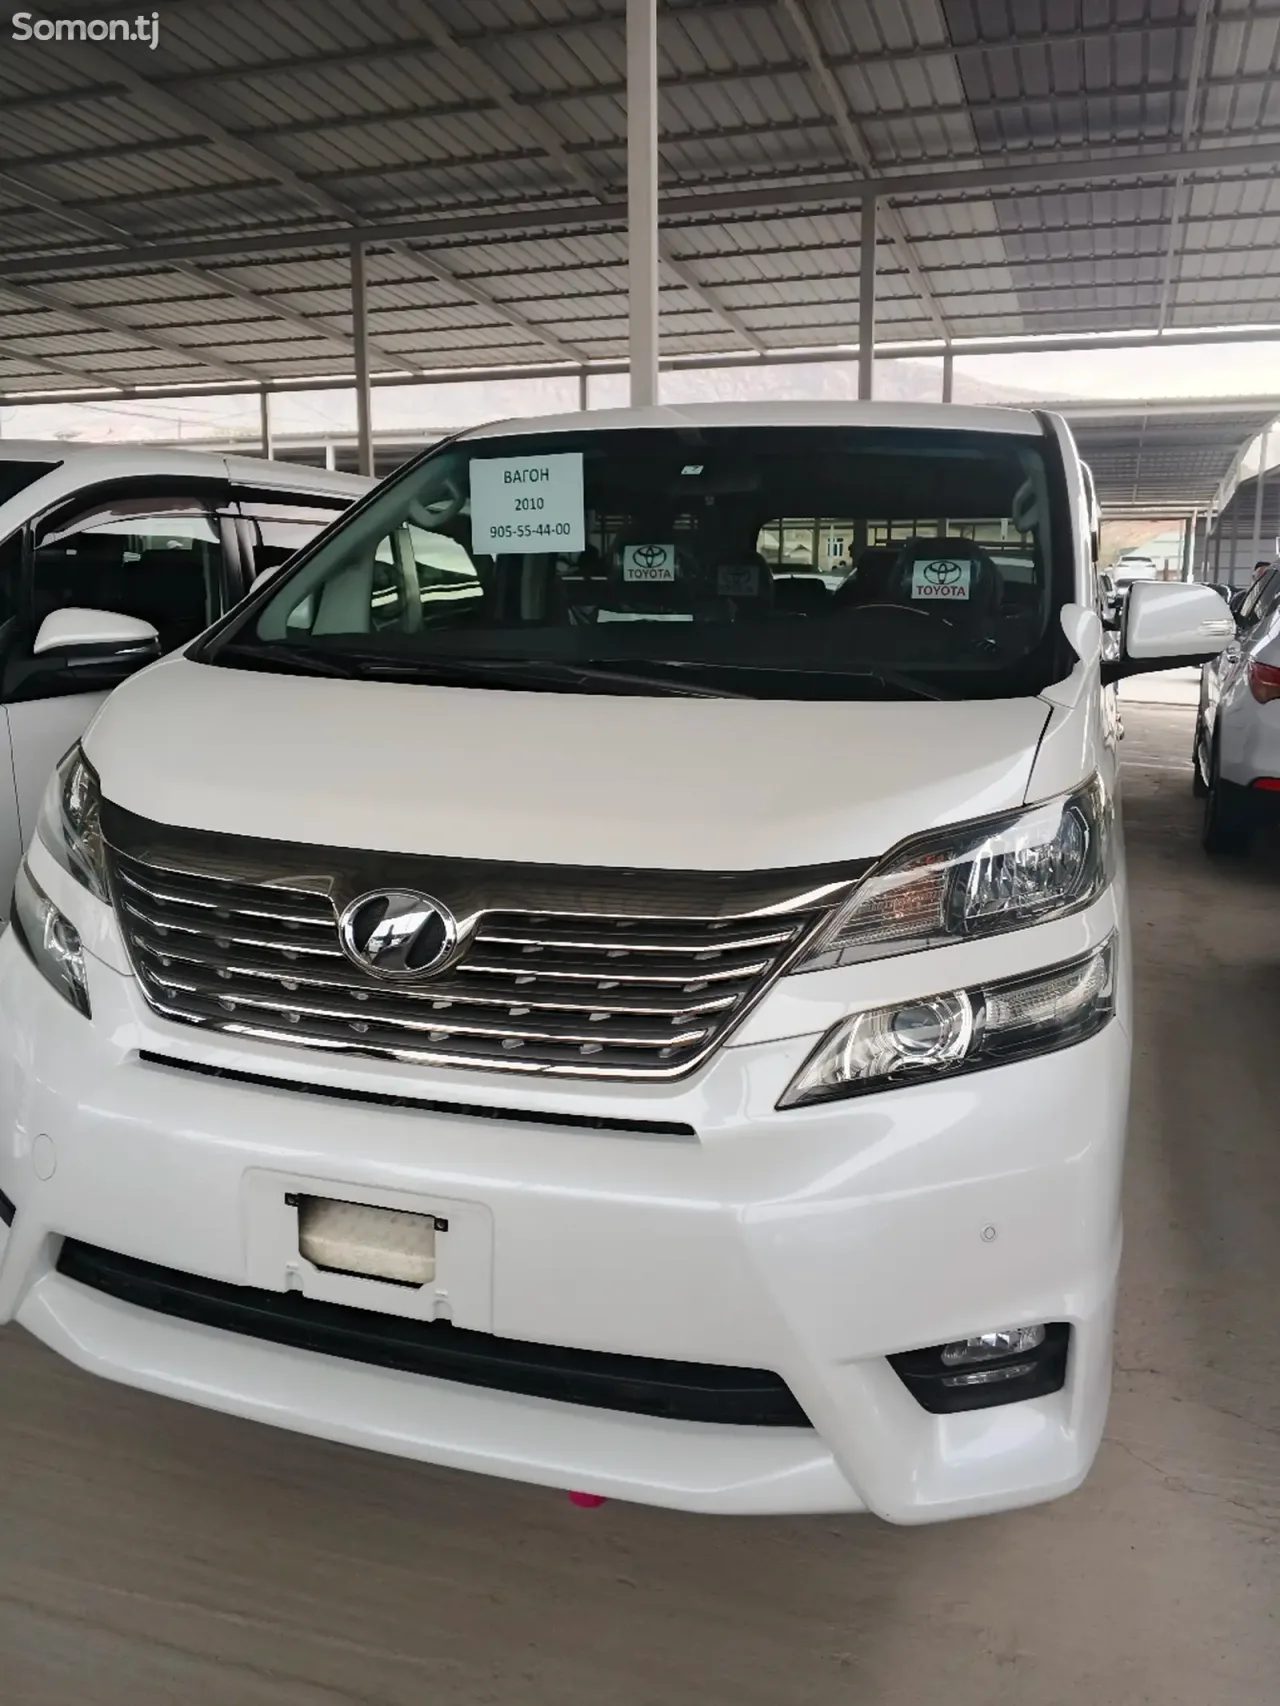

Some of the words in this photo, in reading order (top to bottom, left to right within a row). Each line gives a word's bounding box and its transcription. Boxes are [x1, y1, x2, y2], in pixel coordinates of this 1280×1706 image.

[503, 467, 550, 484] ВАГОН
[514, 497, 545, 512] 2010
[489, 522, 571, 538] 905-55-44-00
[627, 568, 672, 579] TOYOTA
[916, 585, 966, 597] TOYOTA
